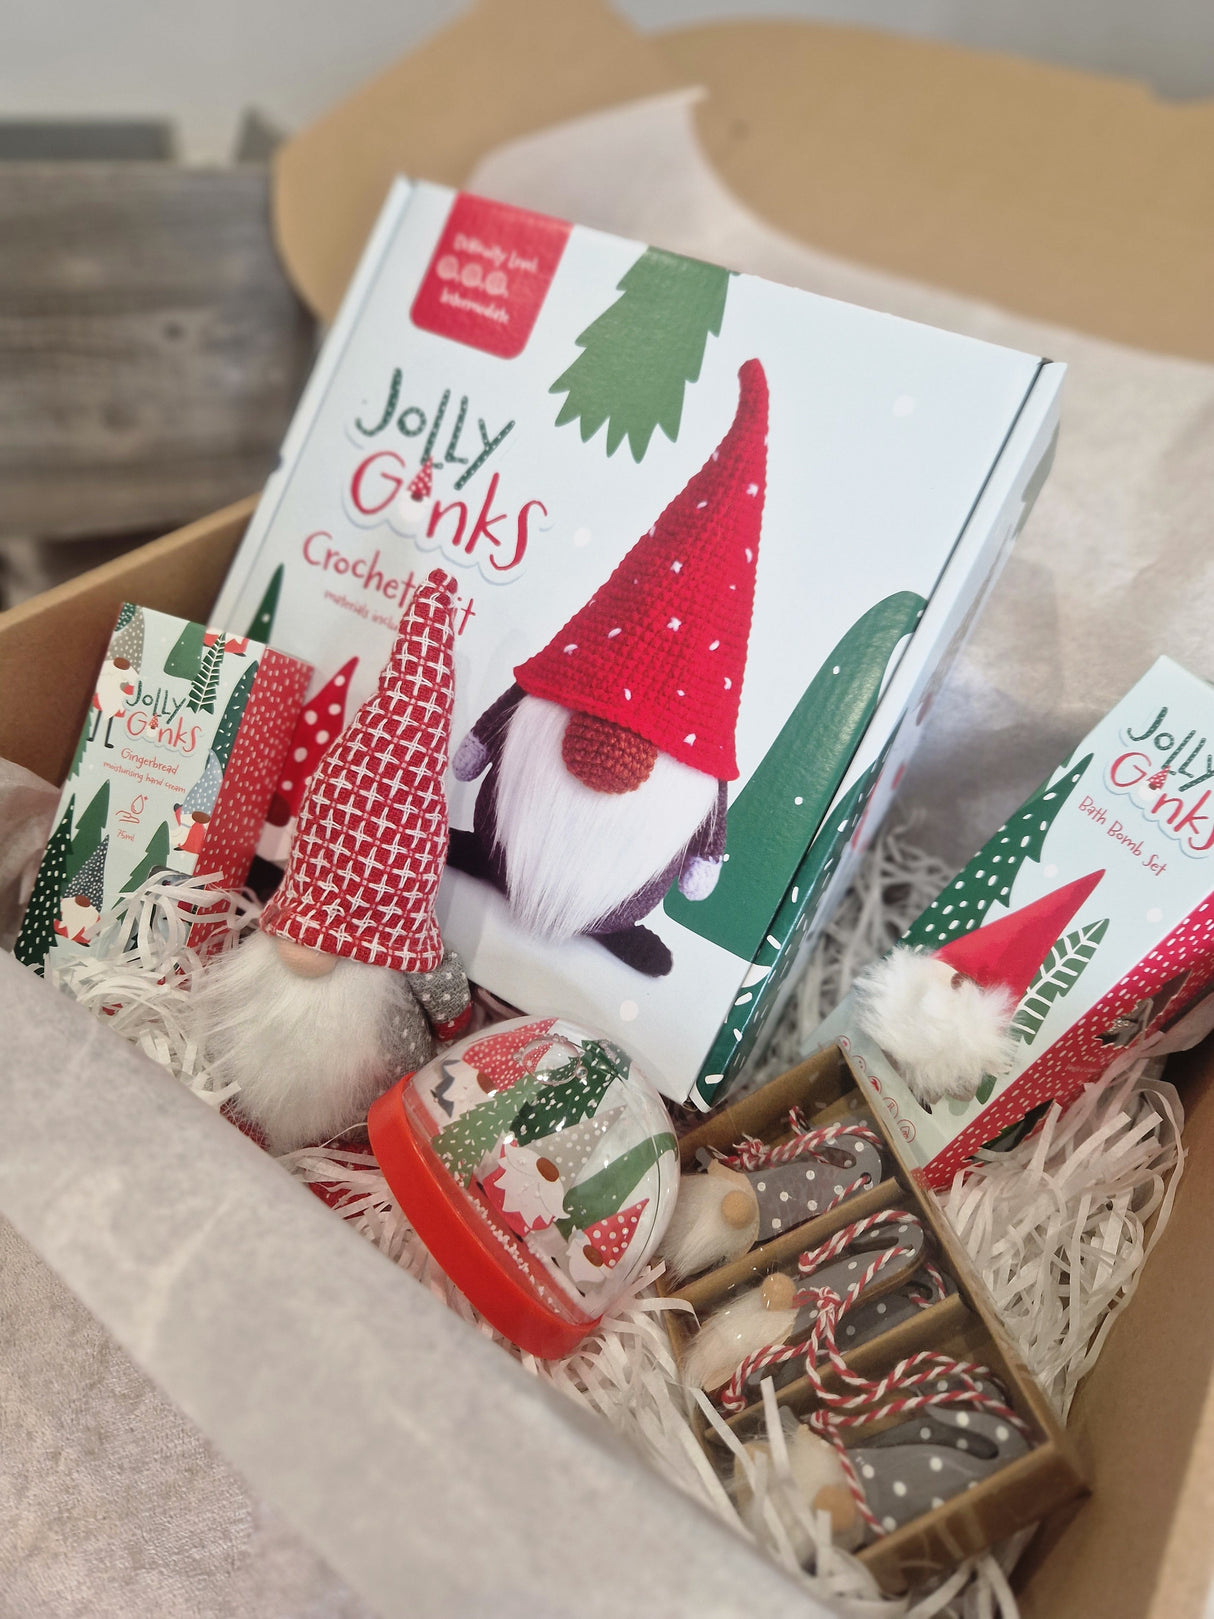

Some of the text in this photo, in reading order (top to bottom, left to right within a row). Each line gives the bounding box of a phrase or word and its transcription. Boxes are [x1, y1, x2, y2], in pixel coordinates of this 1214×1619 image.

[302, 530, 416, 608] Crochet
[120, 747, 180, 776] Gingerbread
[145, 773, 164, 791] hand
[164, 781, 186, 793] cream
[116, 828, 136, 842] 75ml
[1077, 795, 1168, 877] Bath Bomb Set
